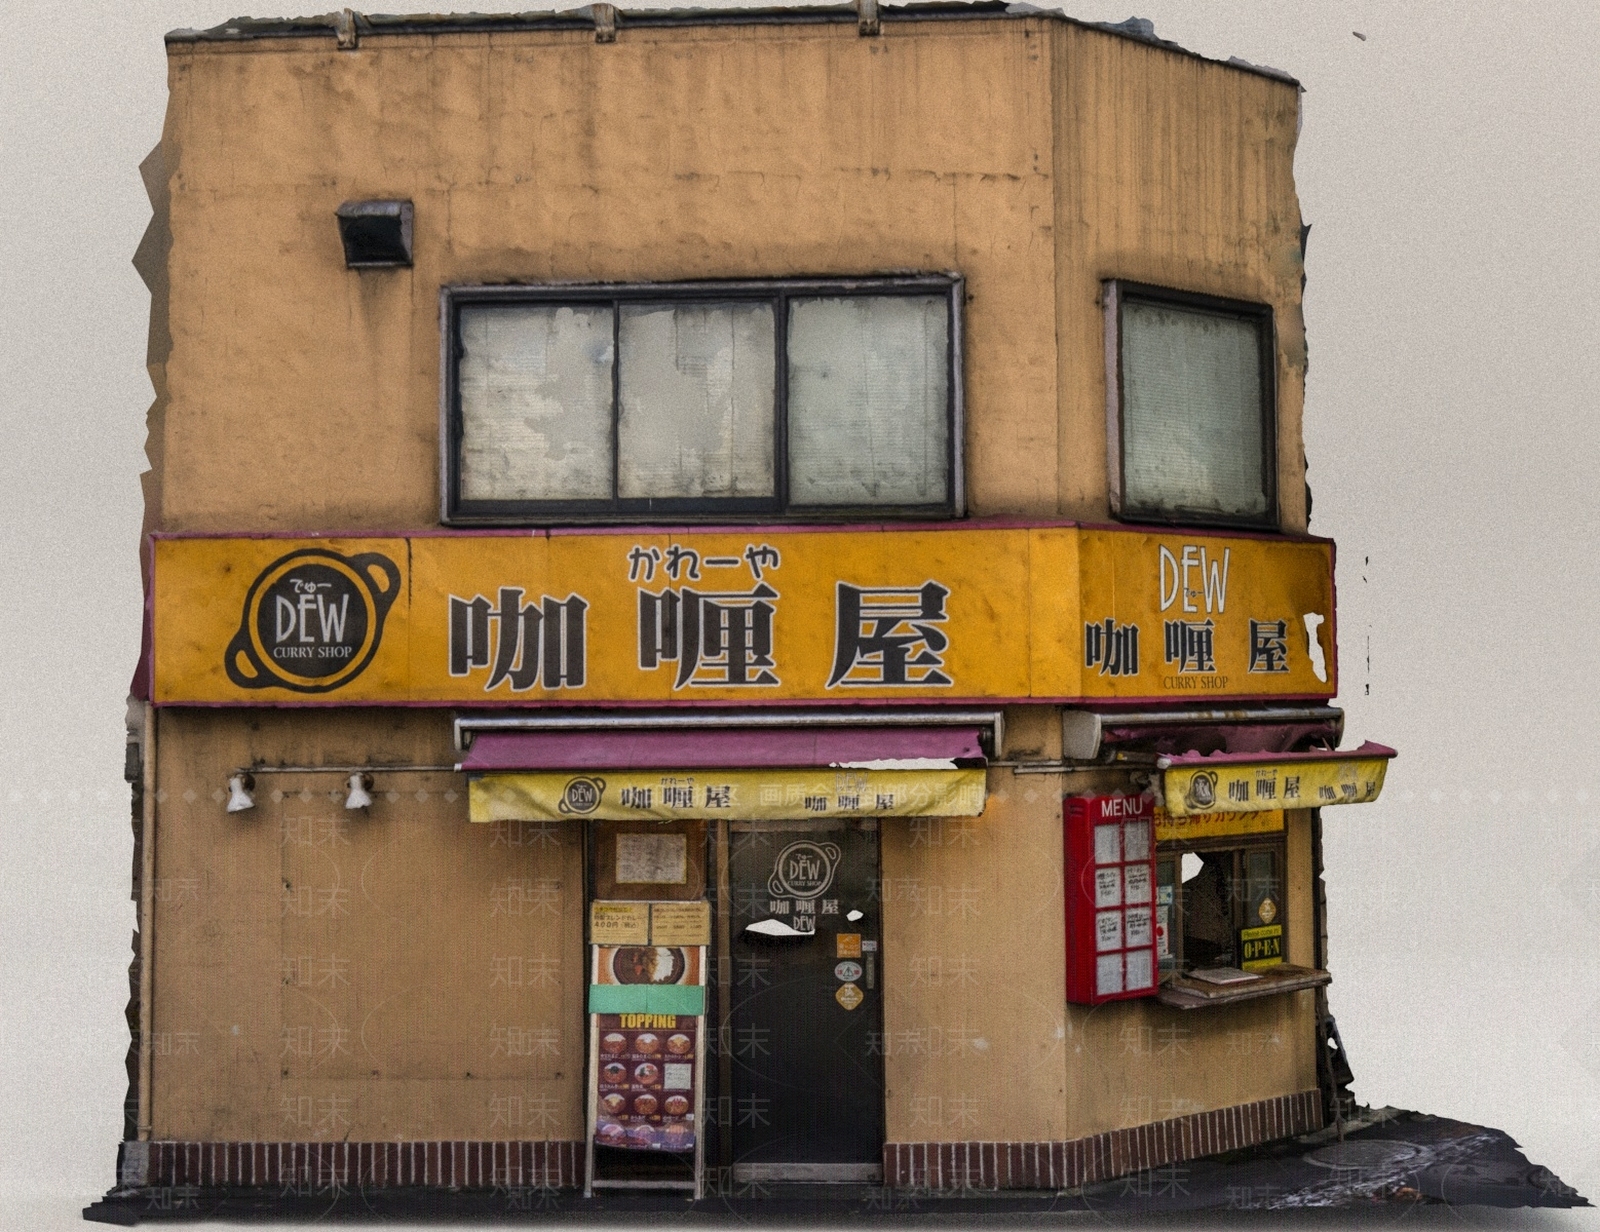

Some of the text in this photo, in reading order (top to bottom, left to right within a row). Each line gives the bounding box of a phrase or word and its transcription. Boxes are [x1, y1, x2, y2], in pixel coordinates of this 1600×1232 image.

[628, 545, 781, 580] かれーや
[289, 579, 332, 593] でゅー
[1159, 544, 1230, 613] DEW
[275, 594, 349, 643] DEW
[273, 646, 352, 658] CURRY SHOP
[1163, 676, 1229, 689] CURRY SHOP
[572, 788, 593, 802] DEW
[1101, 799, 1143, 817] MENU
[790, 860, 820, 880] DEW
[793, 916, 816, 931] DEW
[619, 1014, 676, 1028] TOPPING
